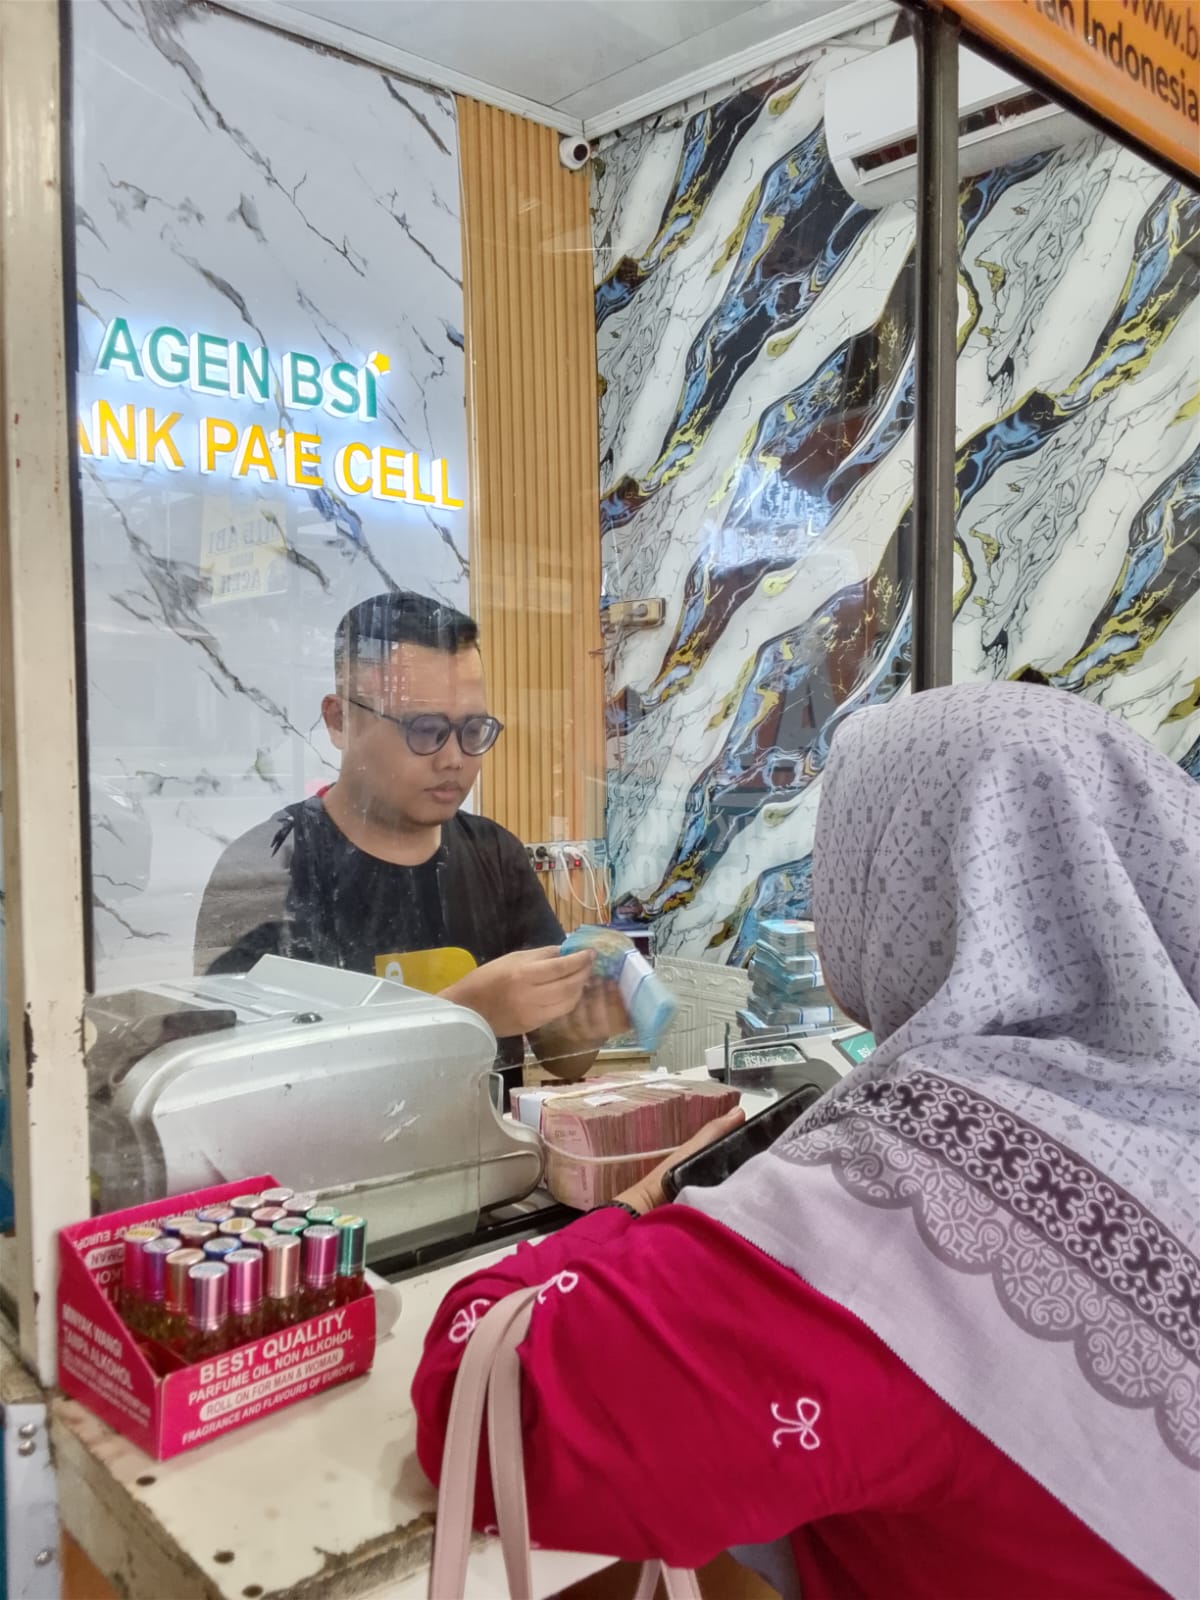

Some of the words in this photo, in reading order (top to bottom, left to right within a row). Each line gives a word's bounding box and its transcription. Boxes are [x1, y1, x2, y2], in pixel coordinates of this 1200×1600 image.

[1083, 0, 1199, 126] Indonesia
[1122, 0, 1199, 60] ww.b
[96, 317, 270, 402] AGEN
[285, 351, 389, 420] BSI
[200, 417, 323, 489] PA'E
[335, 442, 464, 509] CELL
[188, 1371, 250, 1406] PARFUME
[252, 1363, 271, 1379] OIL
[275, 1350, 299, 1371] NON
[302, 1328, 353, 1360] ALKOHOL
[200, 1346, 258, 1384] BEST
[262, 1310, 346, 1359] QUALITY
[206, 1399, 233, 1417] ROLL
[234, 1390, 250, 1405] ON
[252, 1380, 271, 1398] FOR
[274, 1371, 293, 1389] MAN
[296, 1368, 303, 1378] &
[305, 1353, 339, 1375] WOMAN
[182, 1411, 240, 1445] FRAGRANCE
[242, 1401, 261, 1419] AND
[263, 1381, 307, 1409] FLAVOURS
[308, 1376, 321, 1389] OF
[322, 1361, 356, 1384] EUROPE
